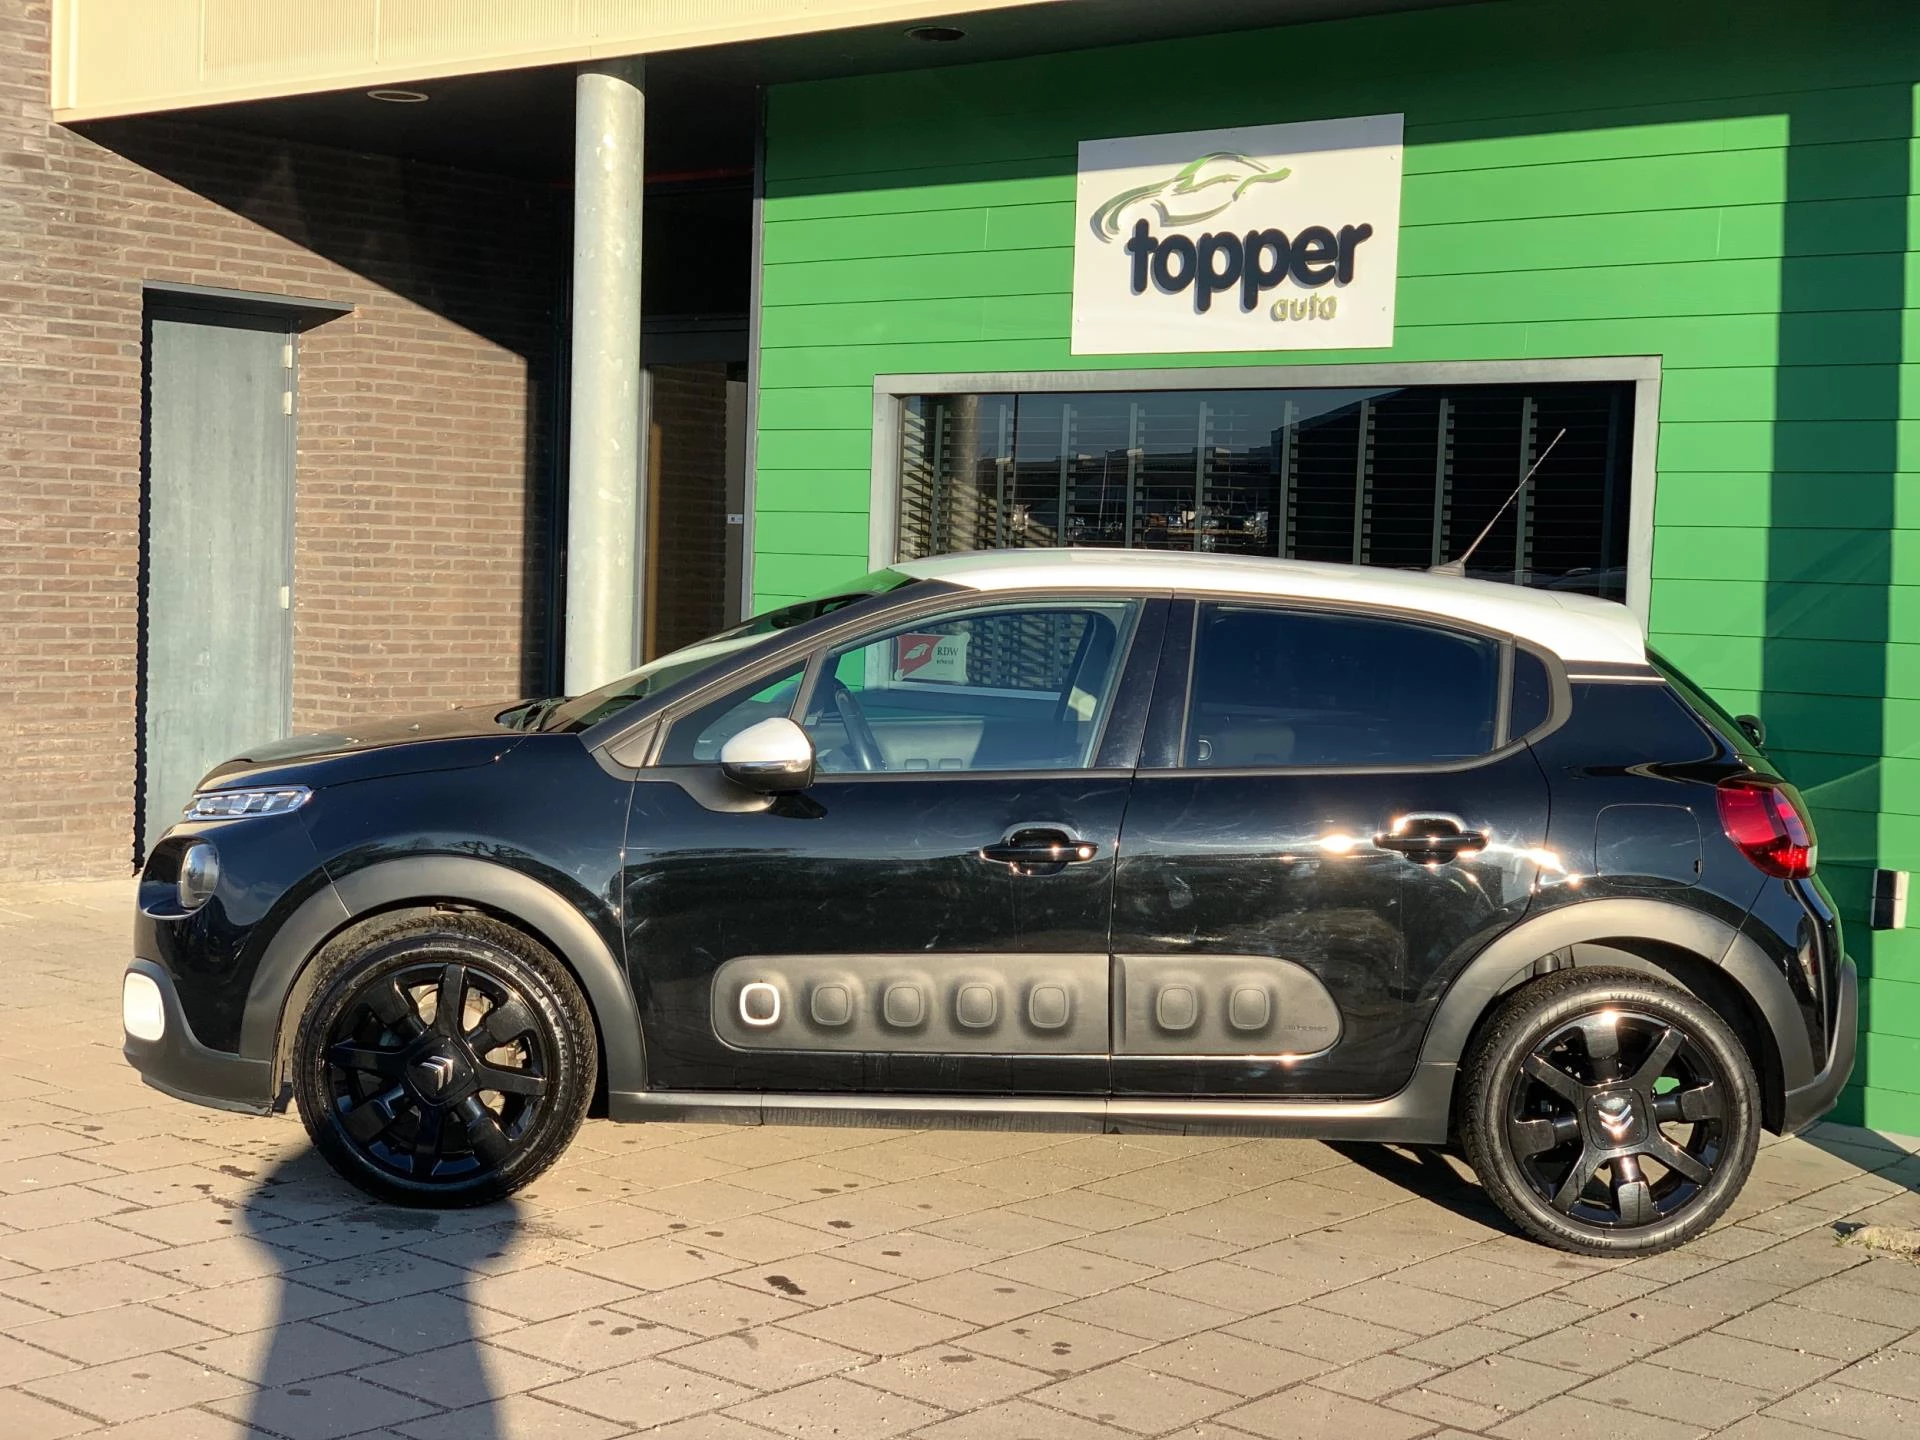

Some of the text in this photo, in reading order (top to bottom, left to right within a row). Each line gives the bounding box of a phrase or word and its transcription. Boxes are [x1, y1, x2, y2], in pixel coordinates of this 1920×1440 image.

[1127, 218, 1373, 312] topper
[1272, 293, 1338, 321] auto
[937, 646, 959, 656] RDW
